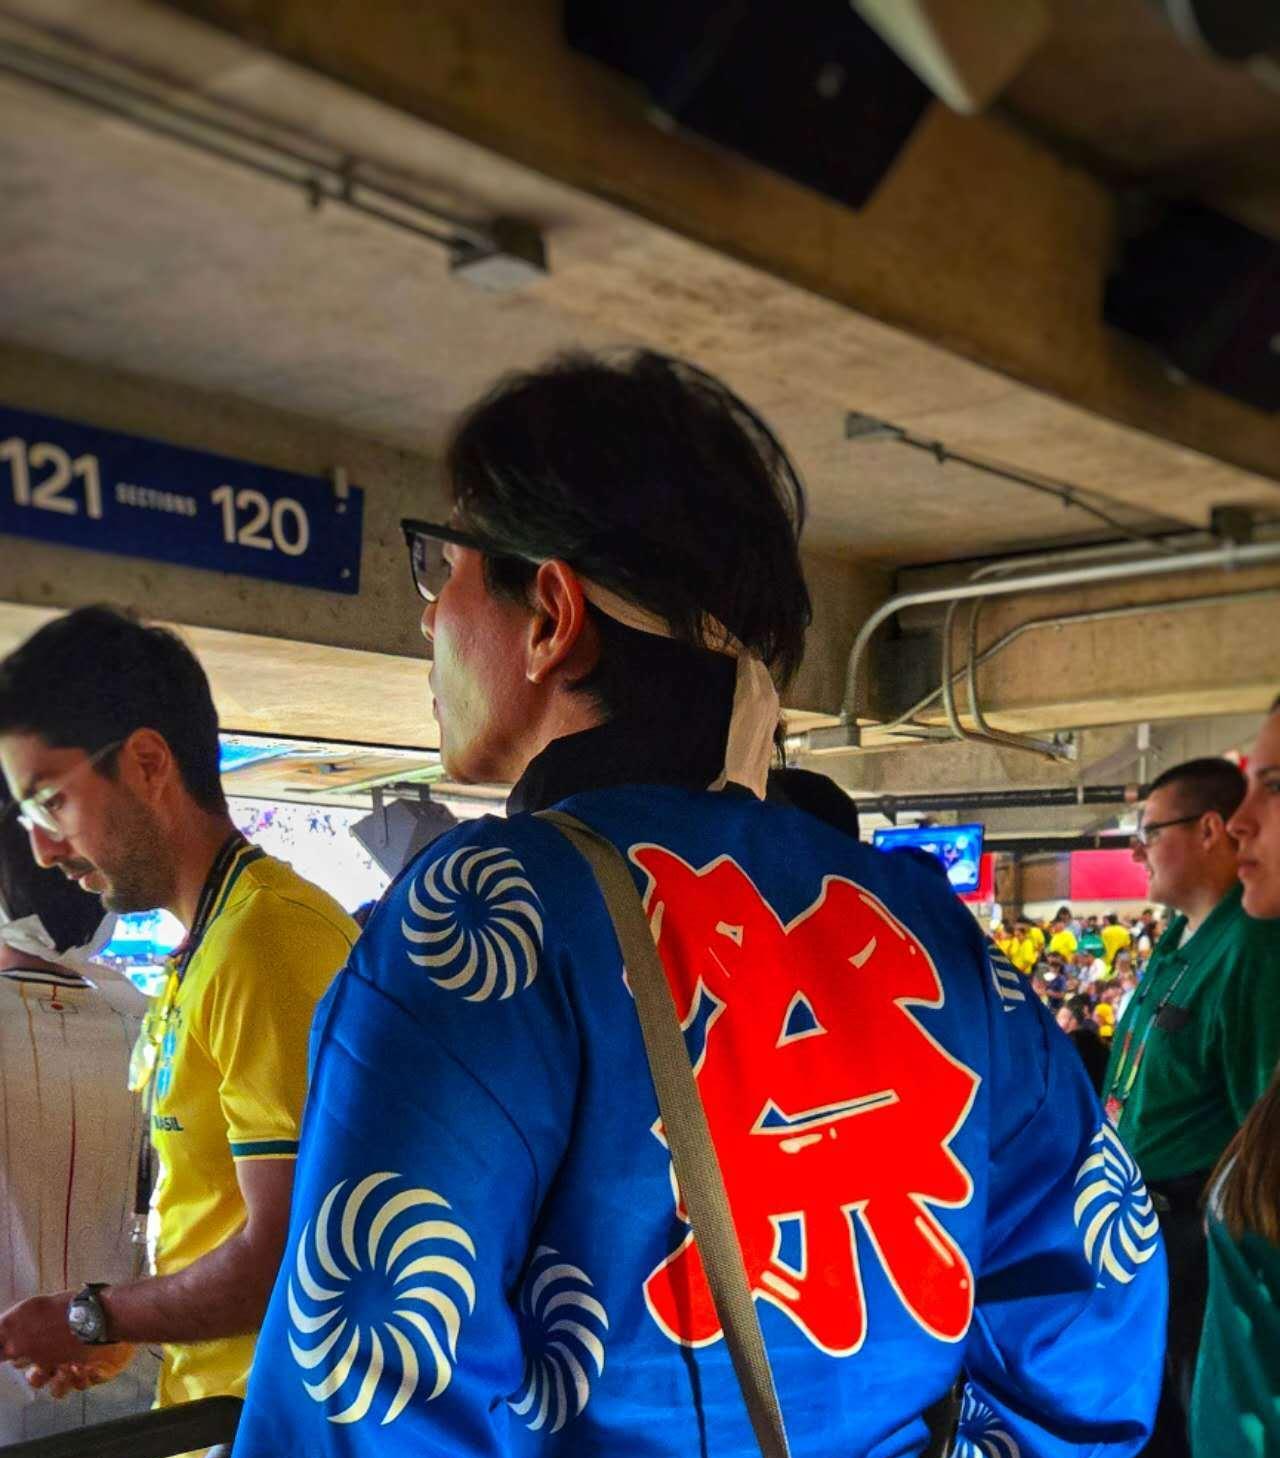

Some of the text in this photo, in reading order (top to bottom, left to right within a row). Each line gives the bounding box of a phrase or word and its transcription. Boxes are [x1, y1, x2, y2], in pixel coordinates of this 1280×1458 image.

[0, 437, 310, 556] 121 SECTIONS 120
[625, 842, 982, 1357] 祭
